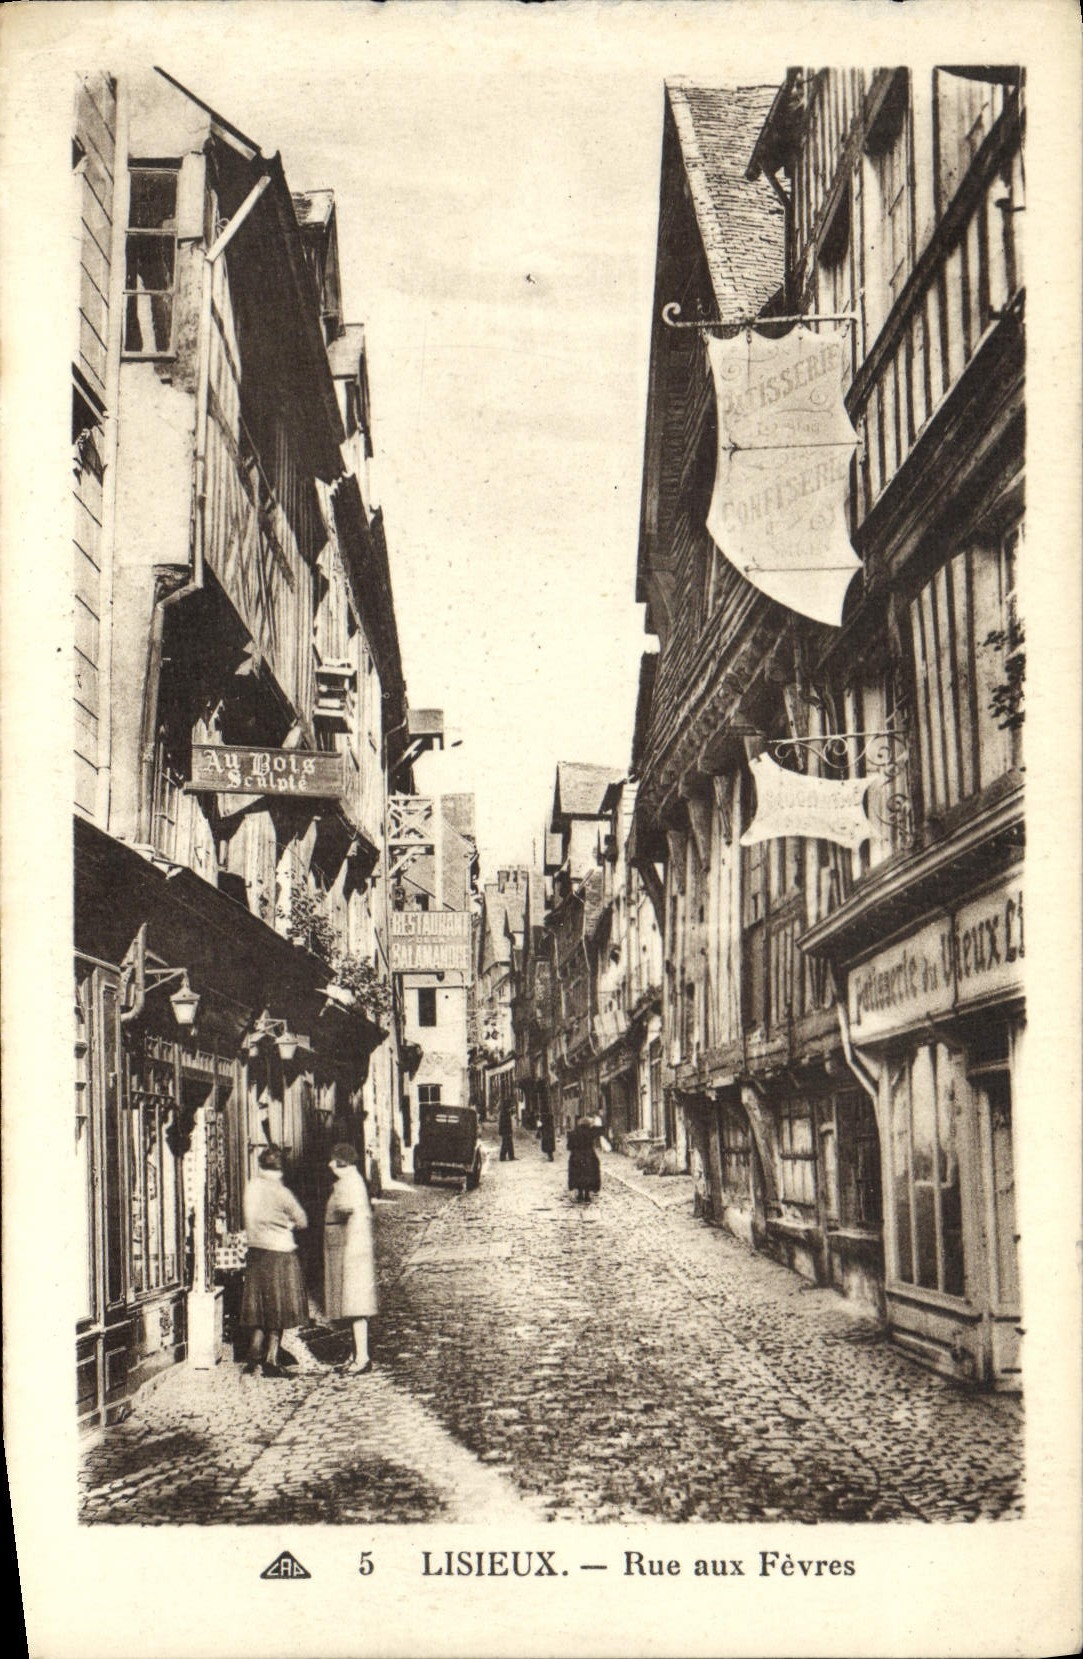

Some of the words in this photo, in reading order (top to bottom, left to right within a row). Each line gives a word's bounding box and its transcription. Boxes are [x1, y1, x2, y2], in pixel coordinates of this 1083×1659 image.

[203, 750, 241, 774] Au
[250, 752, 316, 776] Bois
[227, 769, 308, 792] Sculpté
[392, 913, 469, 936] RESTAURANT
